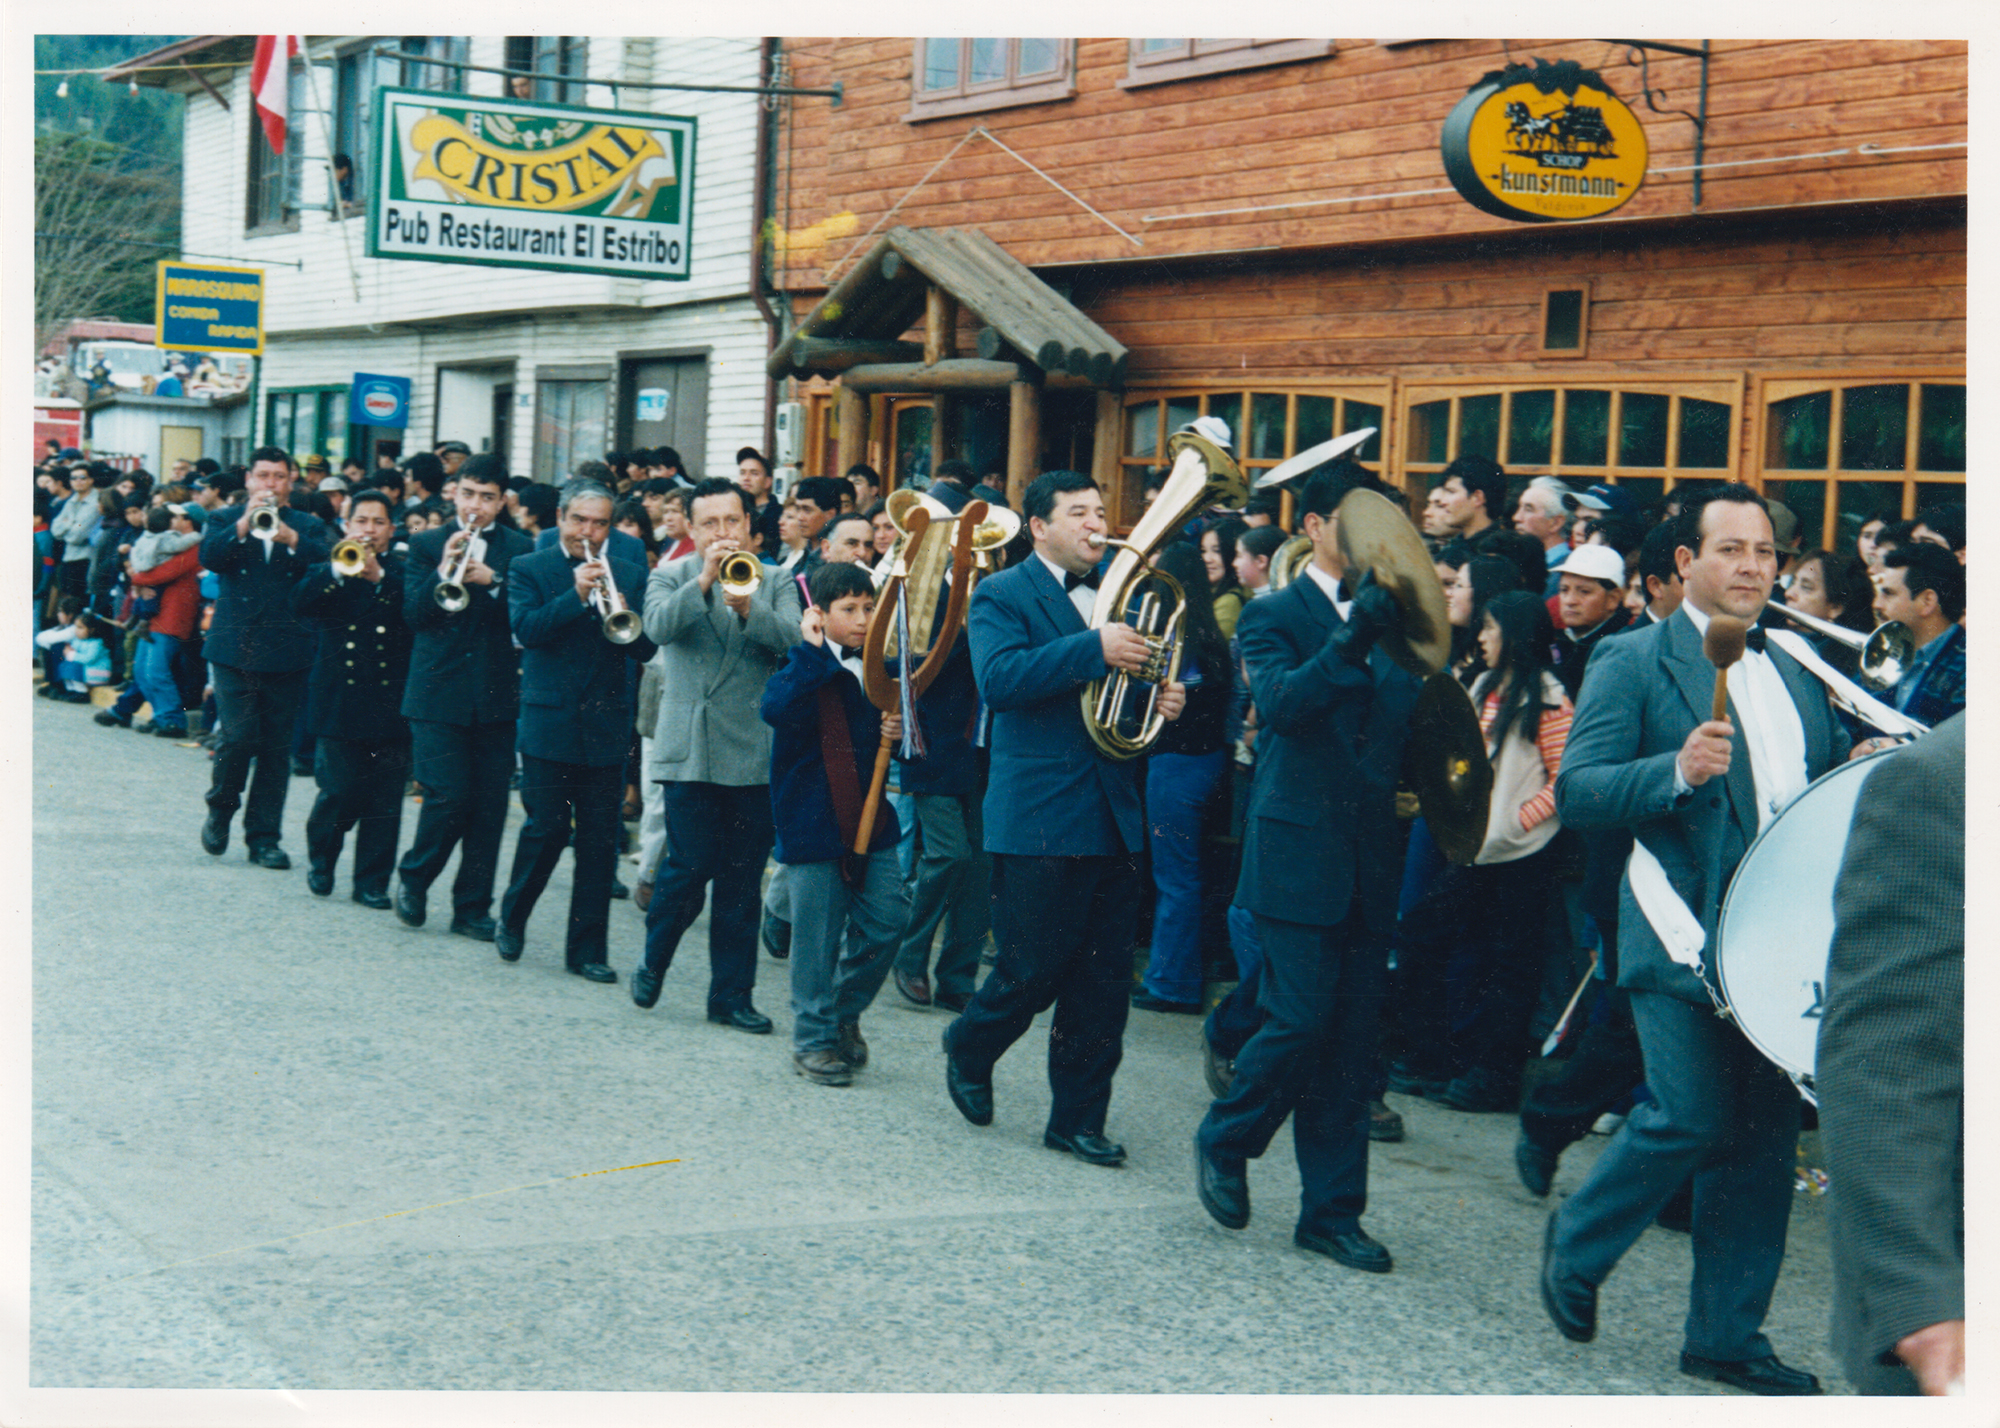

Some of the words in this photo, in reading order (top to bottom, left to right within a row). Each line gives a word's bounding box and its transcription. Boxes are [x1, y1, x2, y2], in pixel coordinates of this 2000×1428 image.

[432, 127, 648, 204] CRISTAL
[1501, 162, 1617, 198] kunstmann
[1541, 153, 1583, 168] SCHOP
[385, 207, 429, 245] Pub
[439, 212, 566, 257] Restaurant
[574, 223, 595, 258] El
[602, 225, 681, 265] Estribo
